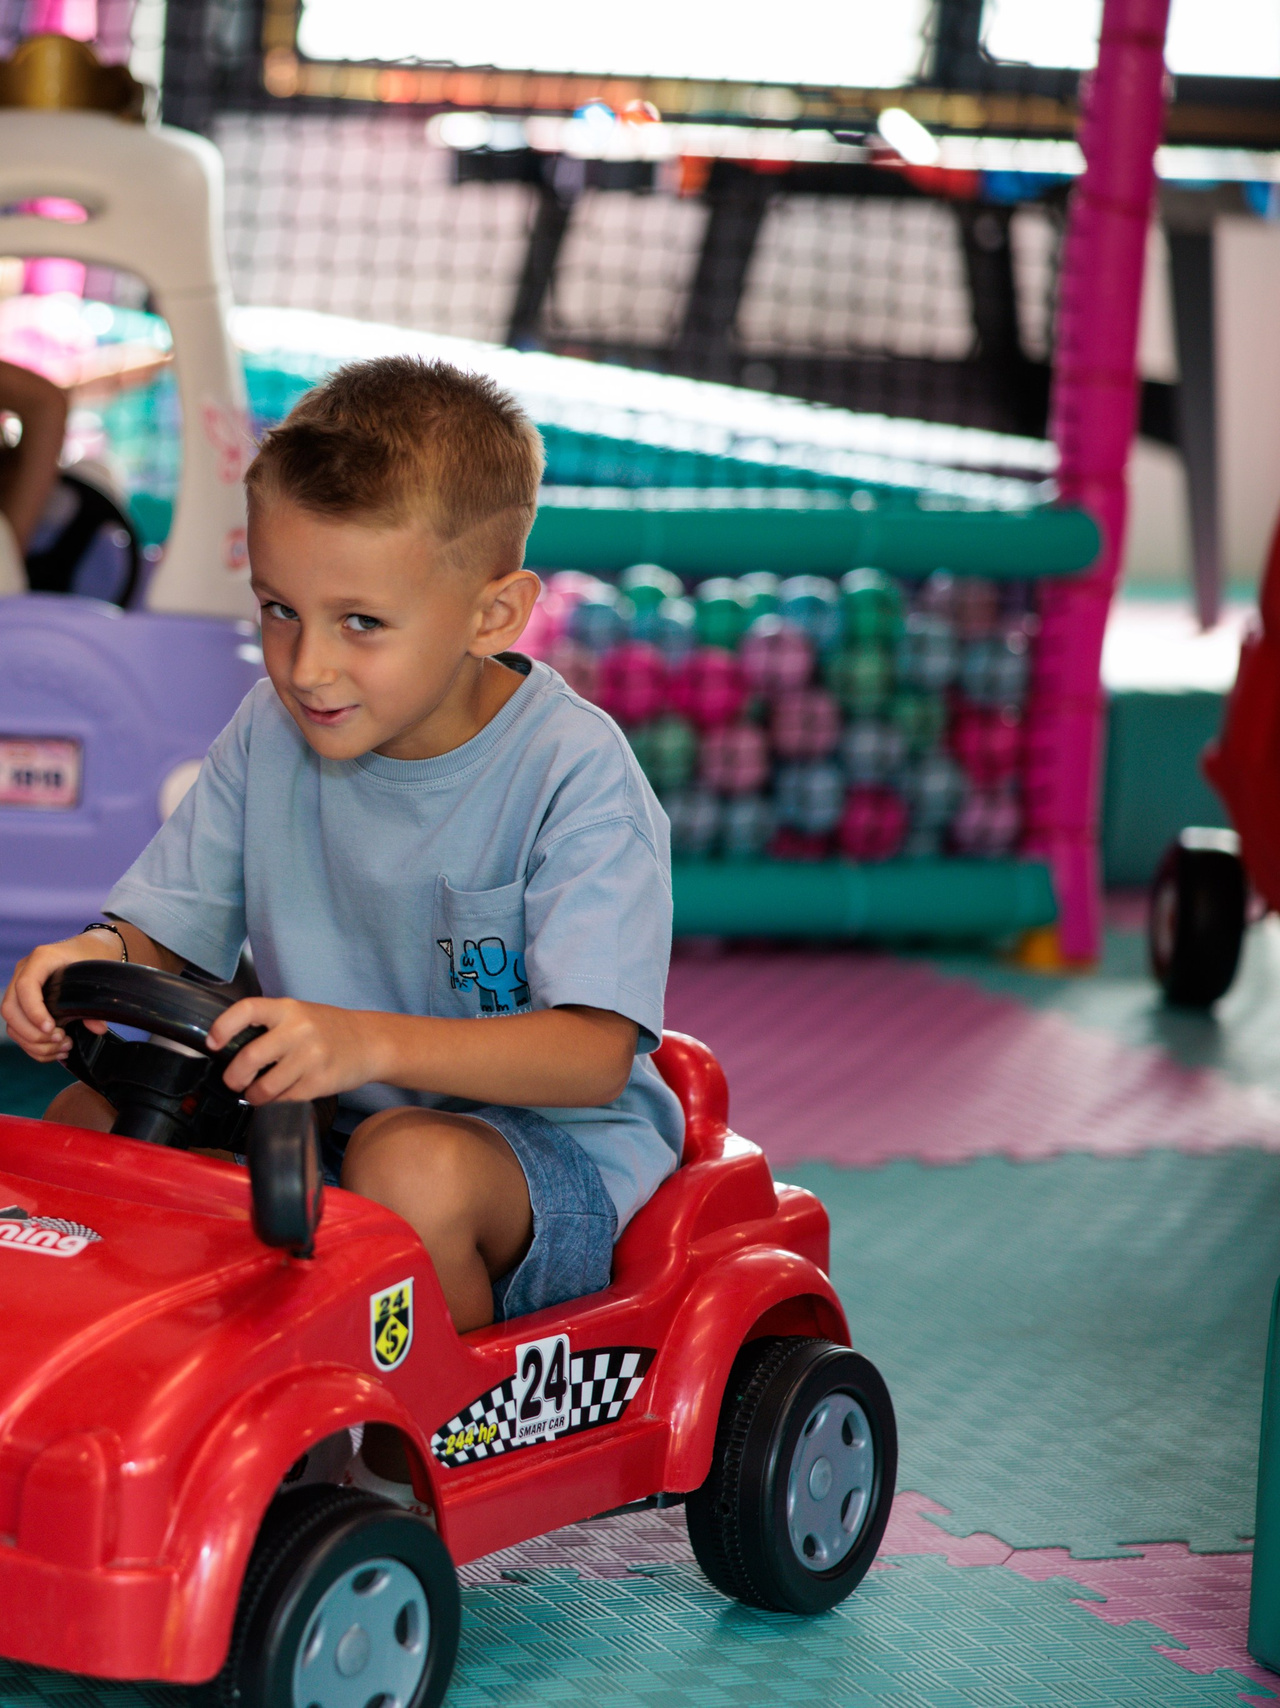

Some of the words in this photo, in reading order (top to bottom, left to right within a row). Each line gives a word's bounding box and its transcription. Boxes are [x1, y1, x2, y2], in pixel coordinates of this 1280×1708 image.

[379, 1288, 404, 1318] 24
[520, 1338, 568, 1422] 24
[445, 1426, 475, 1455] 244
[478, 1422, 497, 1444] hp
[519, 1421, 546, 1438] SMART
[548, 1416, 565, 1430] CAR
